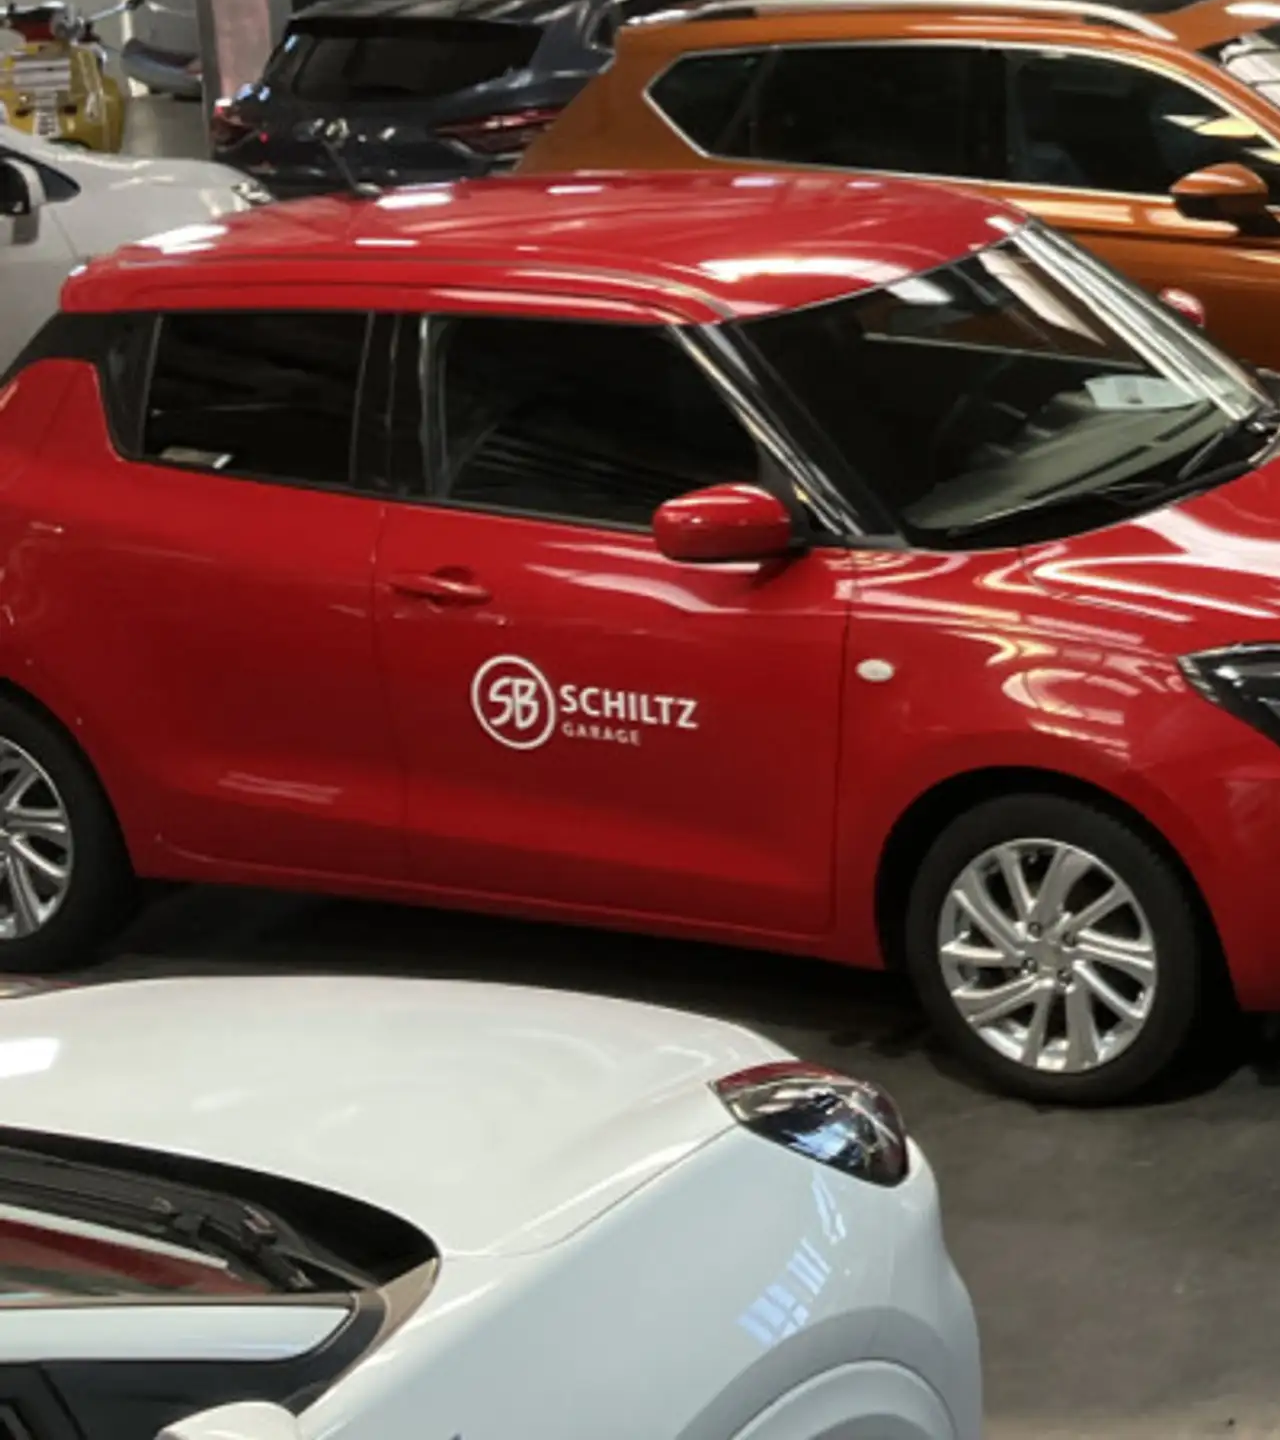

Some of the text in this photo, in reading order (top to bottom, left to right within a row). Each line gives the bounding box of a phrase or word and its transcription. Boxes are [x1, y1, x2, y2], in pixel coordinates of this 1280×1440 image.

[488, 676, 700, 730] SB SCHILTZ
[562, 723, 641, 747] GARAGE
